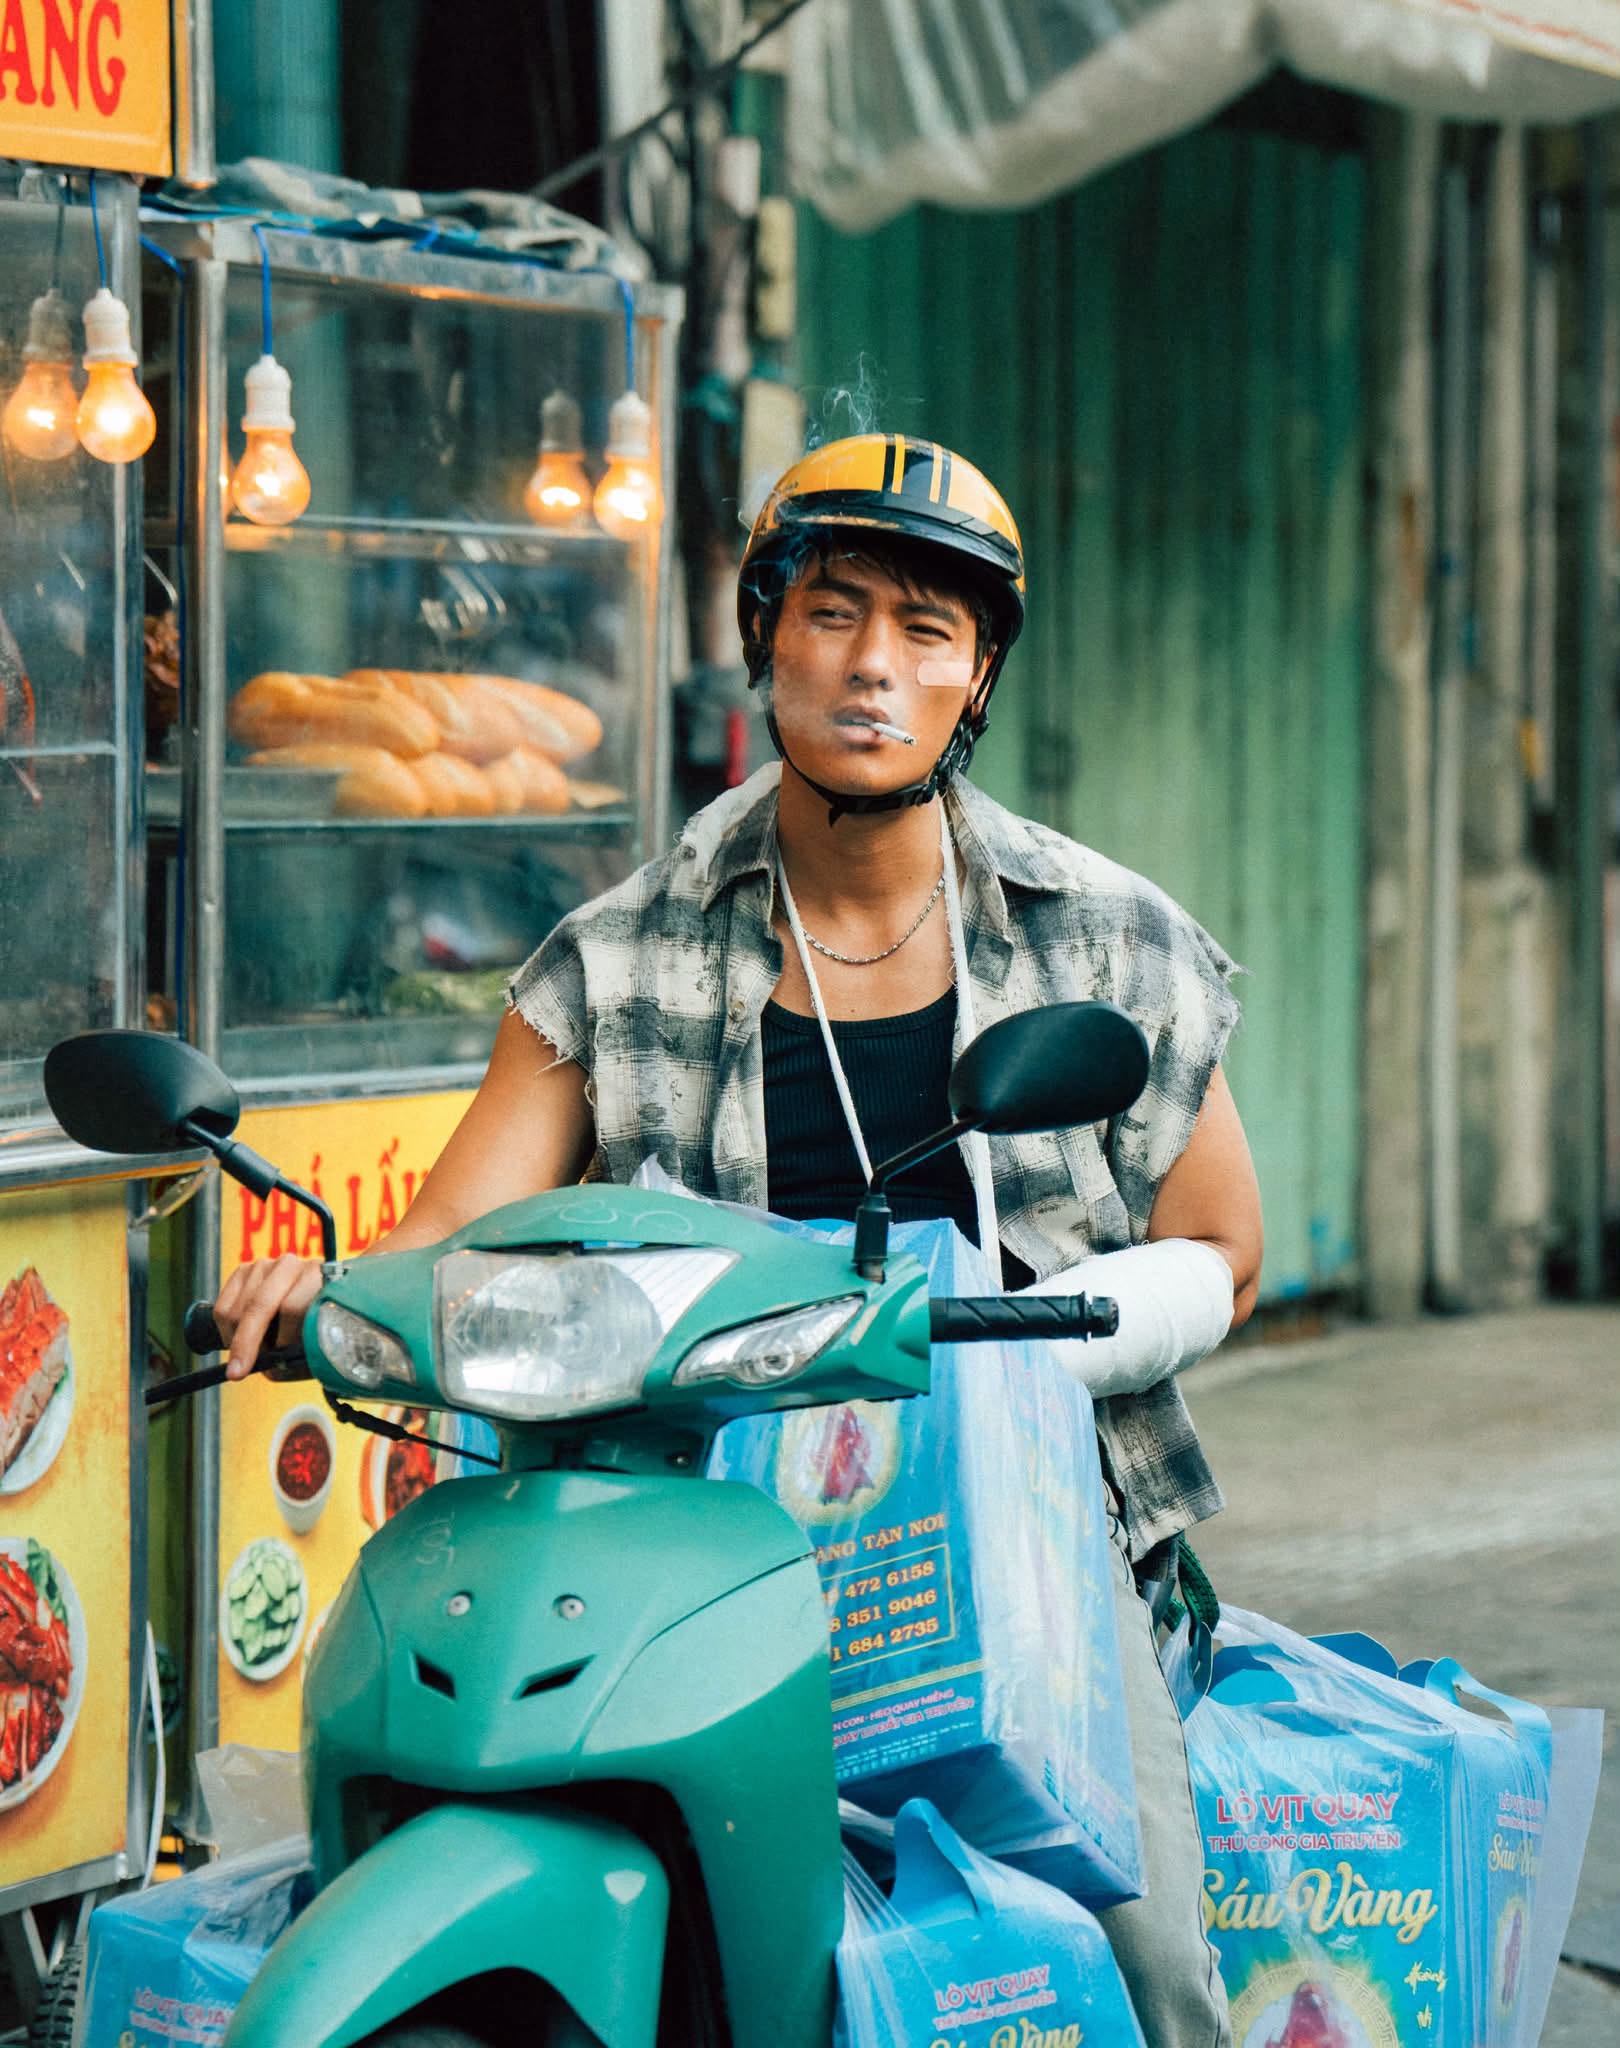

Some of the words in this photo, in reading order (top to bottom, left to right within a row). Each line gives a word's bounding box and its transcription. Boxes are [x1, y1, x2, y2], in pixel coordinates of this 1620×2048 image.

[845, 1577, 881, 1599] 472
[886, 1560, 935, 1587] 6158
[846, 1605, 882, 1628] 351
[888, 1589, 937, 1615] 9046
[848, 1633, 885, 1656] 684
[890, 1617, 939, 1644] 2735
[1216, 1789, 1257, 1824] LÒ
[1260, 1794, 1310, 1829] VỊT
[1313, 1792, 1400, 1827] QUAY
[1247, 1831, 1297, 1851] CÔNG
[1299, 1834, 1330, 1850] GIA
[1287, 1860, 1439, 1945] Vàng
[935, 1982, 964, 2011] LÒ
[964, 1977, 998, 2007] VỊT
[997, 1964, 1050, 1998] QUAY
